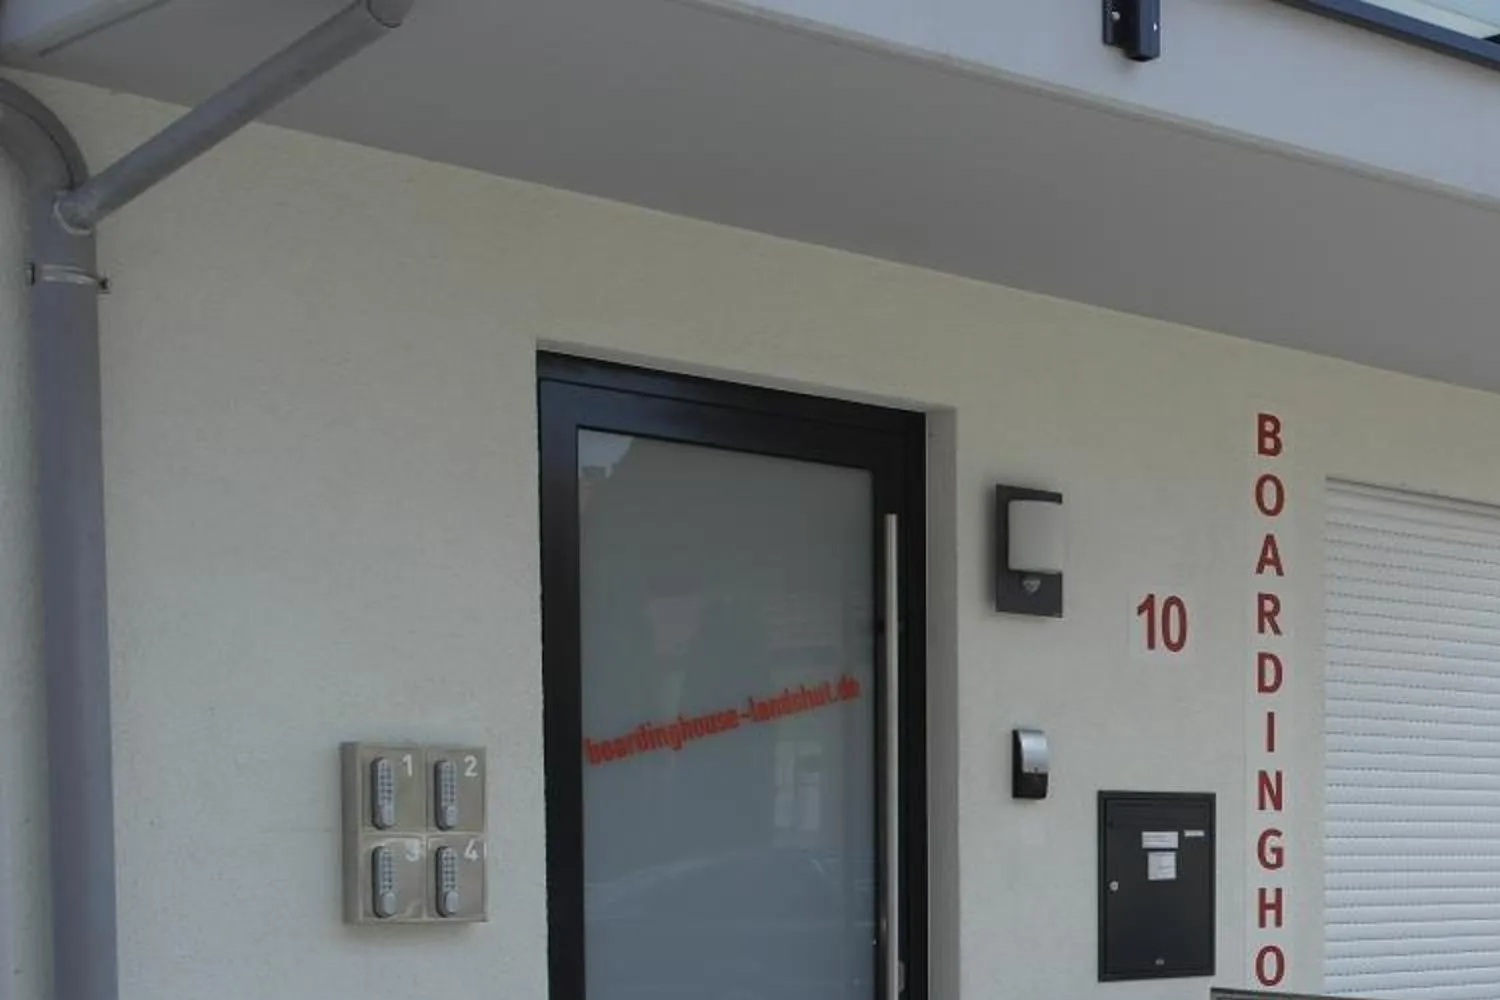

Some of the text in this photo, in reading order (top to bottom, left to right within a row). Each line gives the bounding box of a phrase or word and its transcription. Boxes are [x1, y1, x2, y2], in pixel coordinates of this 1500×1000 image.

[1136, 593, 1187, 653] 10
[402, 754, 413, 777] 1
[464, 755, 479, 777] 2
[464, 838, 480, 861] 4
